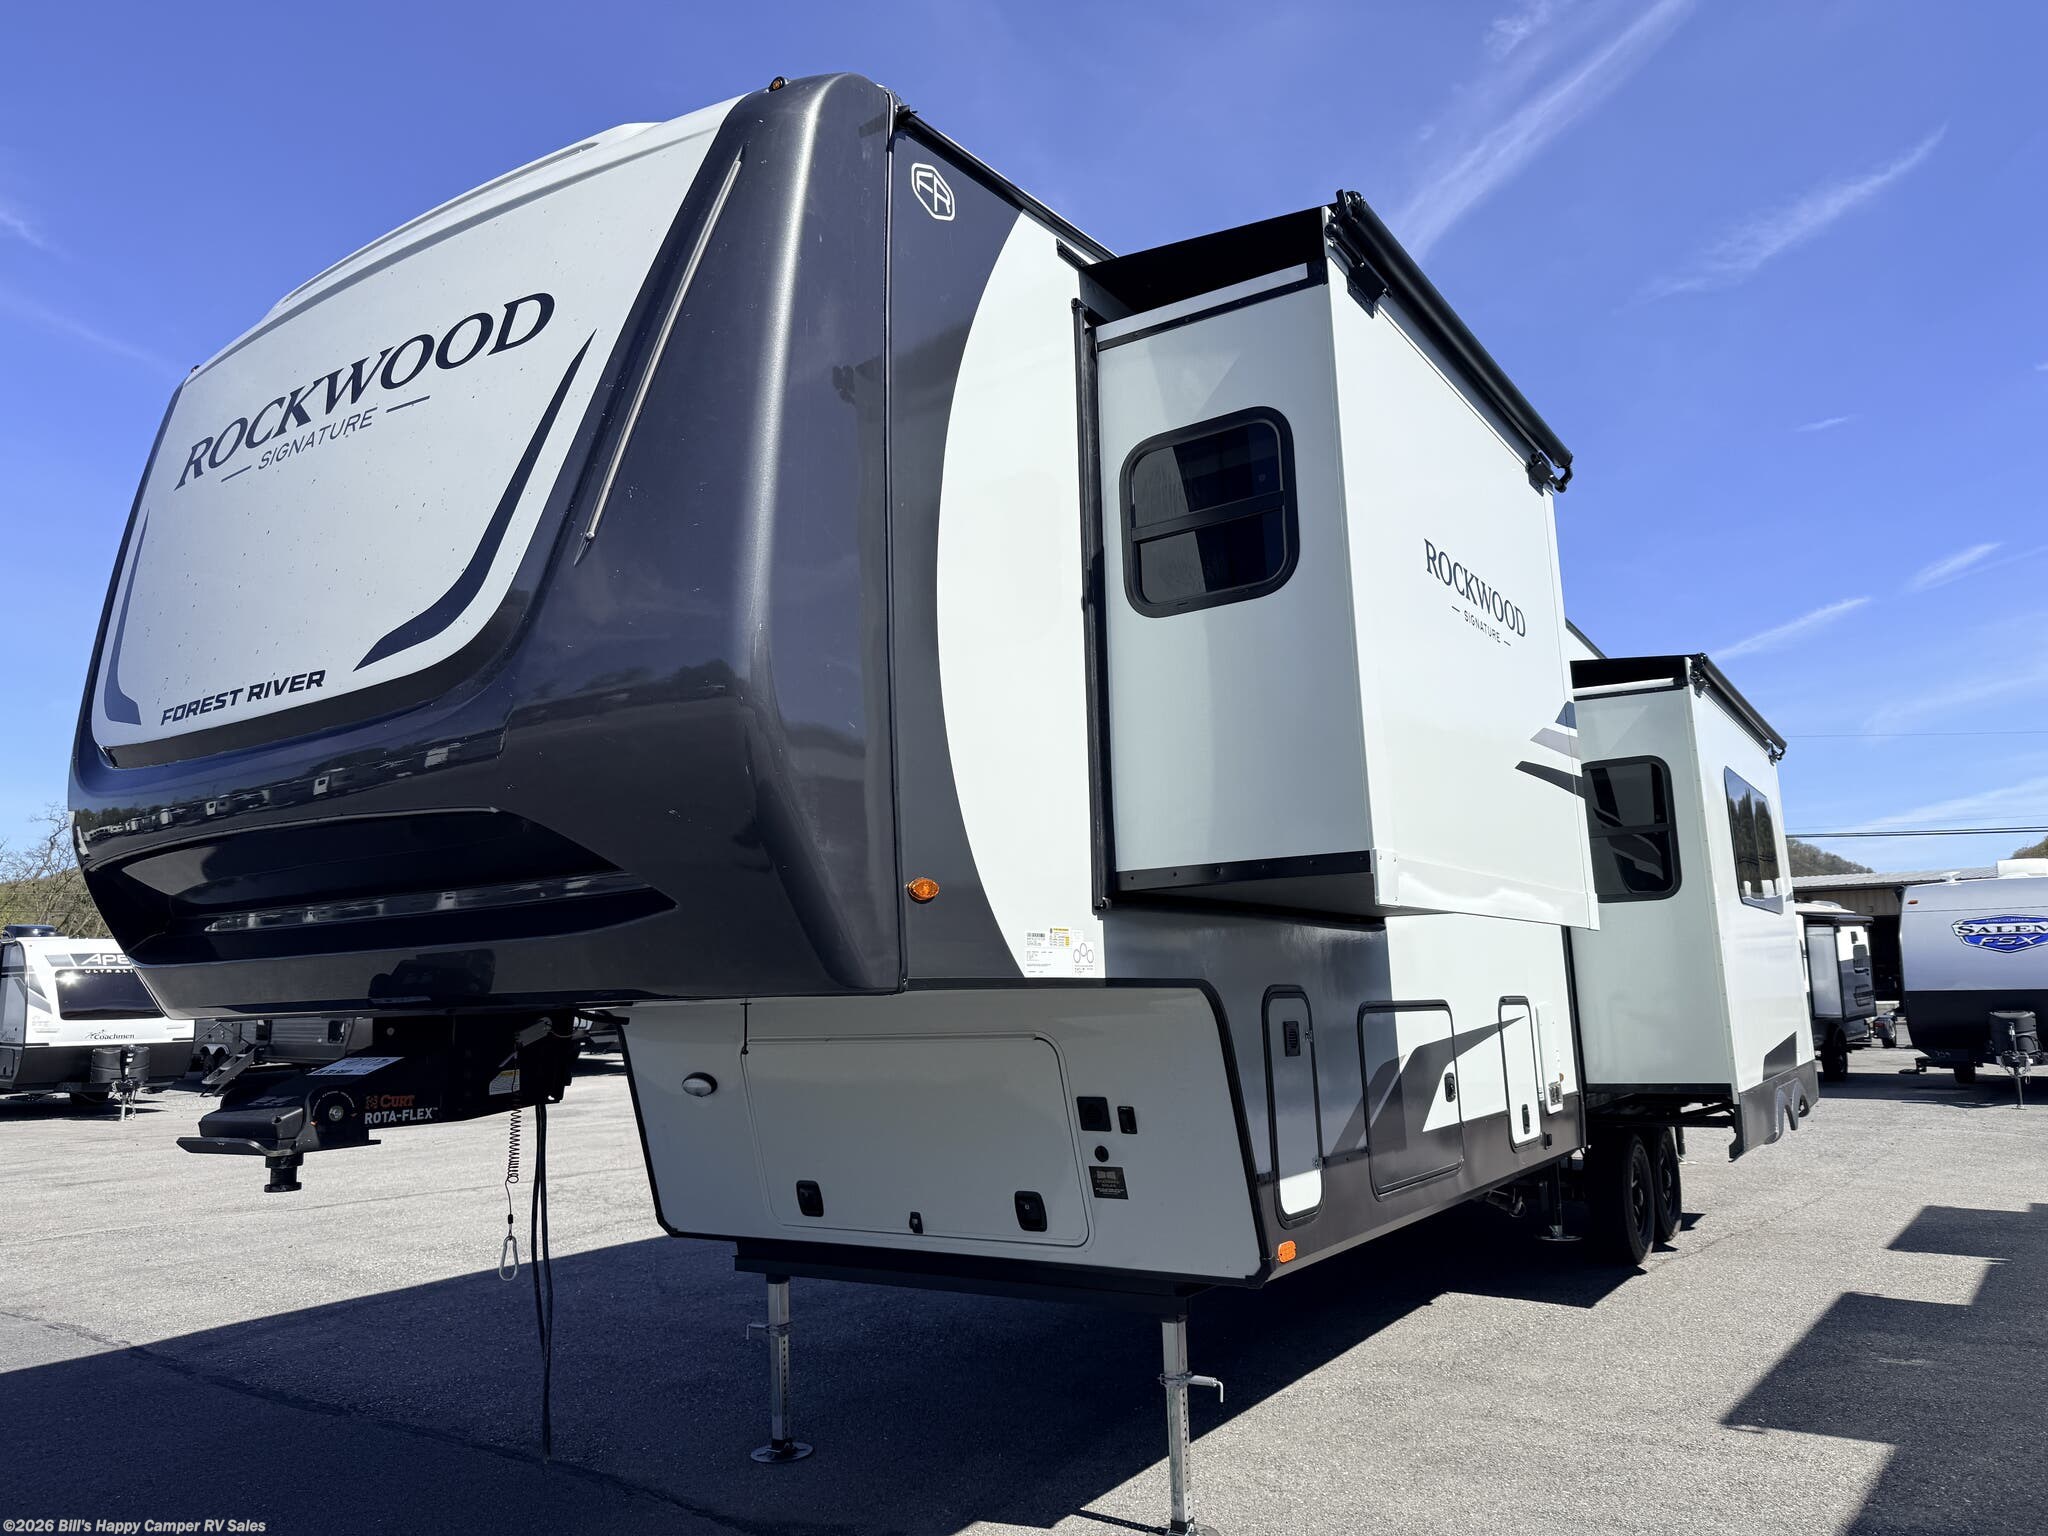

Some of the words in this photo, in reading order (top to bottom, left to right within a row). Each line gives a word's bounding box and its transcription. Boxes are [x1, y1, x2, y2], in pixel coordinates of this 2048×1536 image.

[174, 292, 555, 491] ROCKWOOD
[257, 406, 378, 470] SIGNATURE
[1423, 537, 1526, 638] ROCKWOOD
[1463, 609, 1501, 644] SIGNATURE
[160, 687, 244, 726] FOREST
[246, 669, 326, 703] RIVER
[1979, 934, 2041, 946] FSX
[92, 1031, 135, 1041] Coachmen
